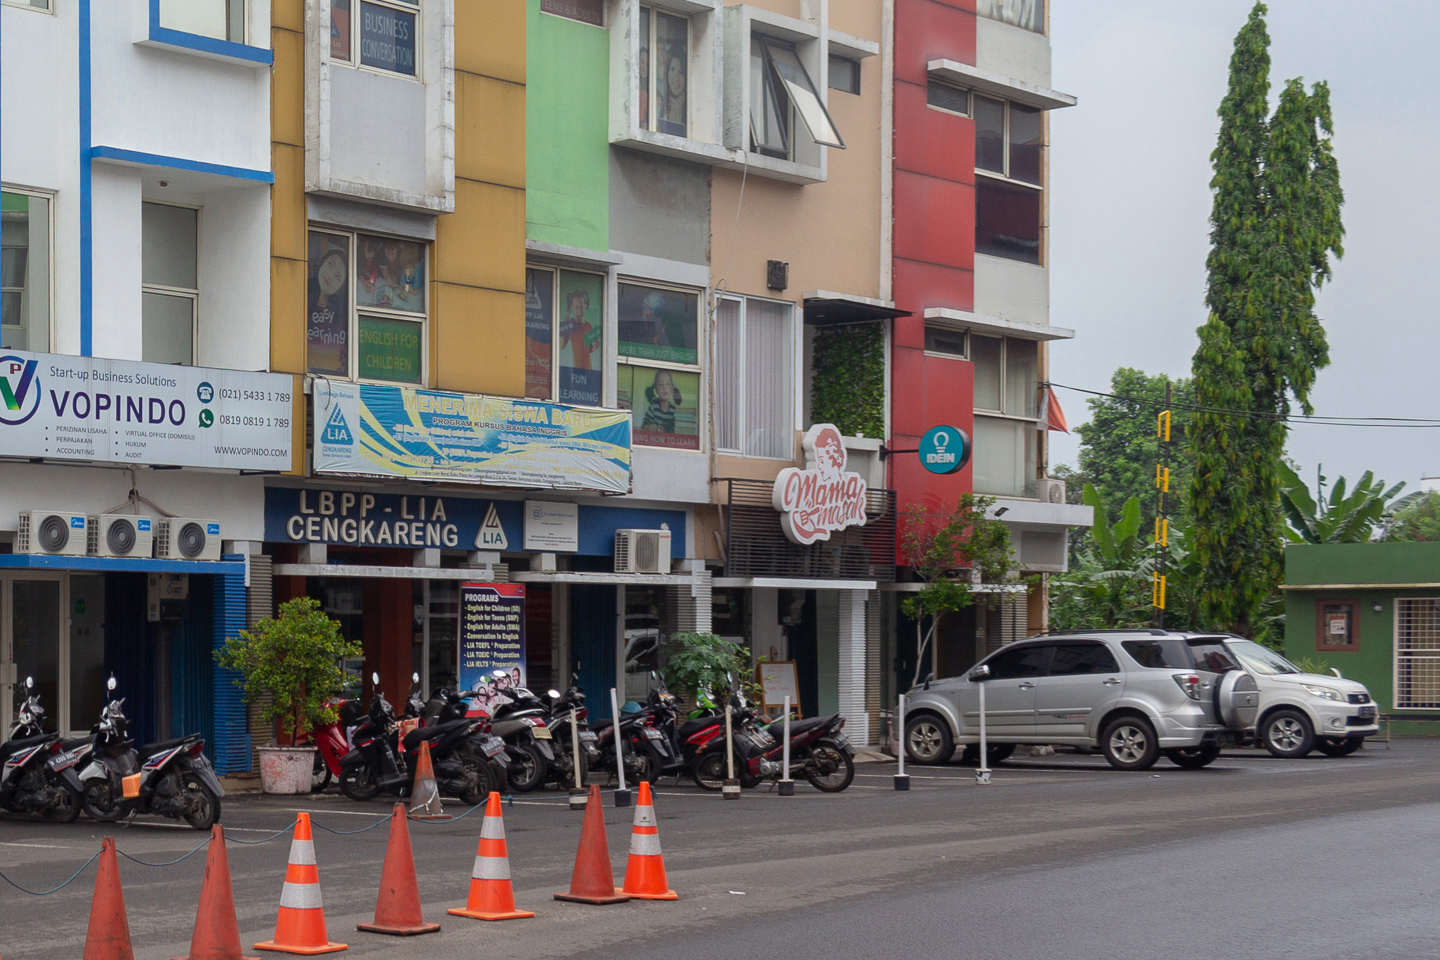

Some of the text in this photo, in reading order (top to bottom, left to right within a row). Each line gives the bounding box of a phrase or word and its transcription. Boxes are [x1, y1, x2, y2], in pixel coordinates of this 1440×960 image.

[365, 12, 408, 40] BUSINESS
[362, 38, 413, 66] CONVERSATION
[312, 308, 334, 324] easy
[360, 329, 418, 348] ENGLISH FOR
[619, 345, 695, 362] MORE THAN JUST ENGLISH
[366, 354, 412, 371] CHILDREN
[50, 366, 176, 388] Start-up Business Solutions
[570, 374, 587, 384] FUN
[218, 387, 290, 403] (021) 5433 1 789
[560, 388, 599, 403] LEARNING
[50, 389, 186, 426] VOPINDO
[404, 394, 593, 428] MENERIMA SISWA BARU
[219, 415, 289, 428] 0819 0819 1 789
[433, 417, 568, 436] PROGRAM KURSUS BAHASA INGGRIS
[56, 426, 86, 434] PERIZINAN
[125, 430, 147, 438] VIRTUAL
[148, 431, 166, 439] OFFICE
[327, 428, 348, 440] LIA
[56, 436, 93, 445] PERPAJAKAN
[650, 435, 665, 444] HOW
[676, 437, 696, 447] LEARN
[56, 448, 95, 456] ACCOUNTING
[214, 446, 288, 457] WWW.VOPINDO.COM
[926, 452, 955, 464] IDEIN
[784, 472, 859, 509] Mama
[299, 490, 376, 518] LBPP
[400, 496, 447, 522] LIA
[286, 514, 459, 547] CENGKARENG
[482, 532, 504, 545] LIA
[465, 593, 499, 602] PROGRAMS
[467, 604, 484, 612] English
[467, 614, 484, 622] English
[467, 623, 483, 631] English
[502, 633, 519, 641] English
